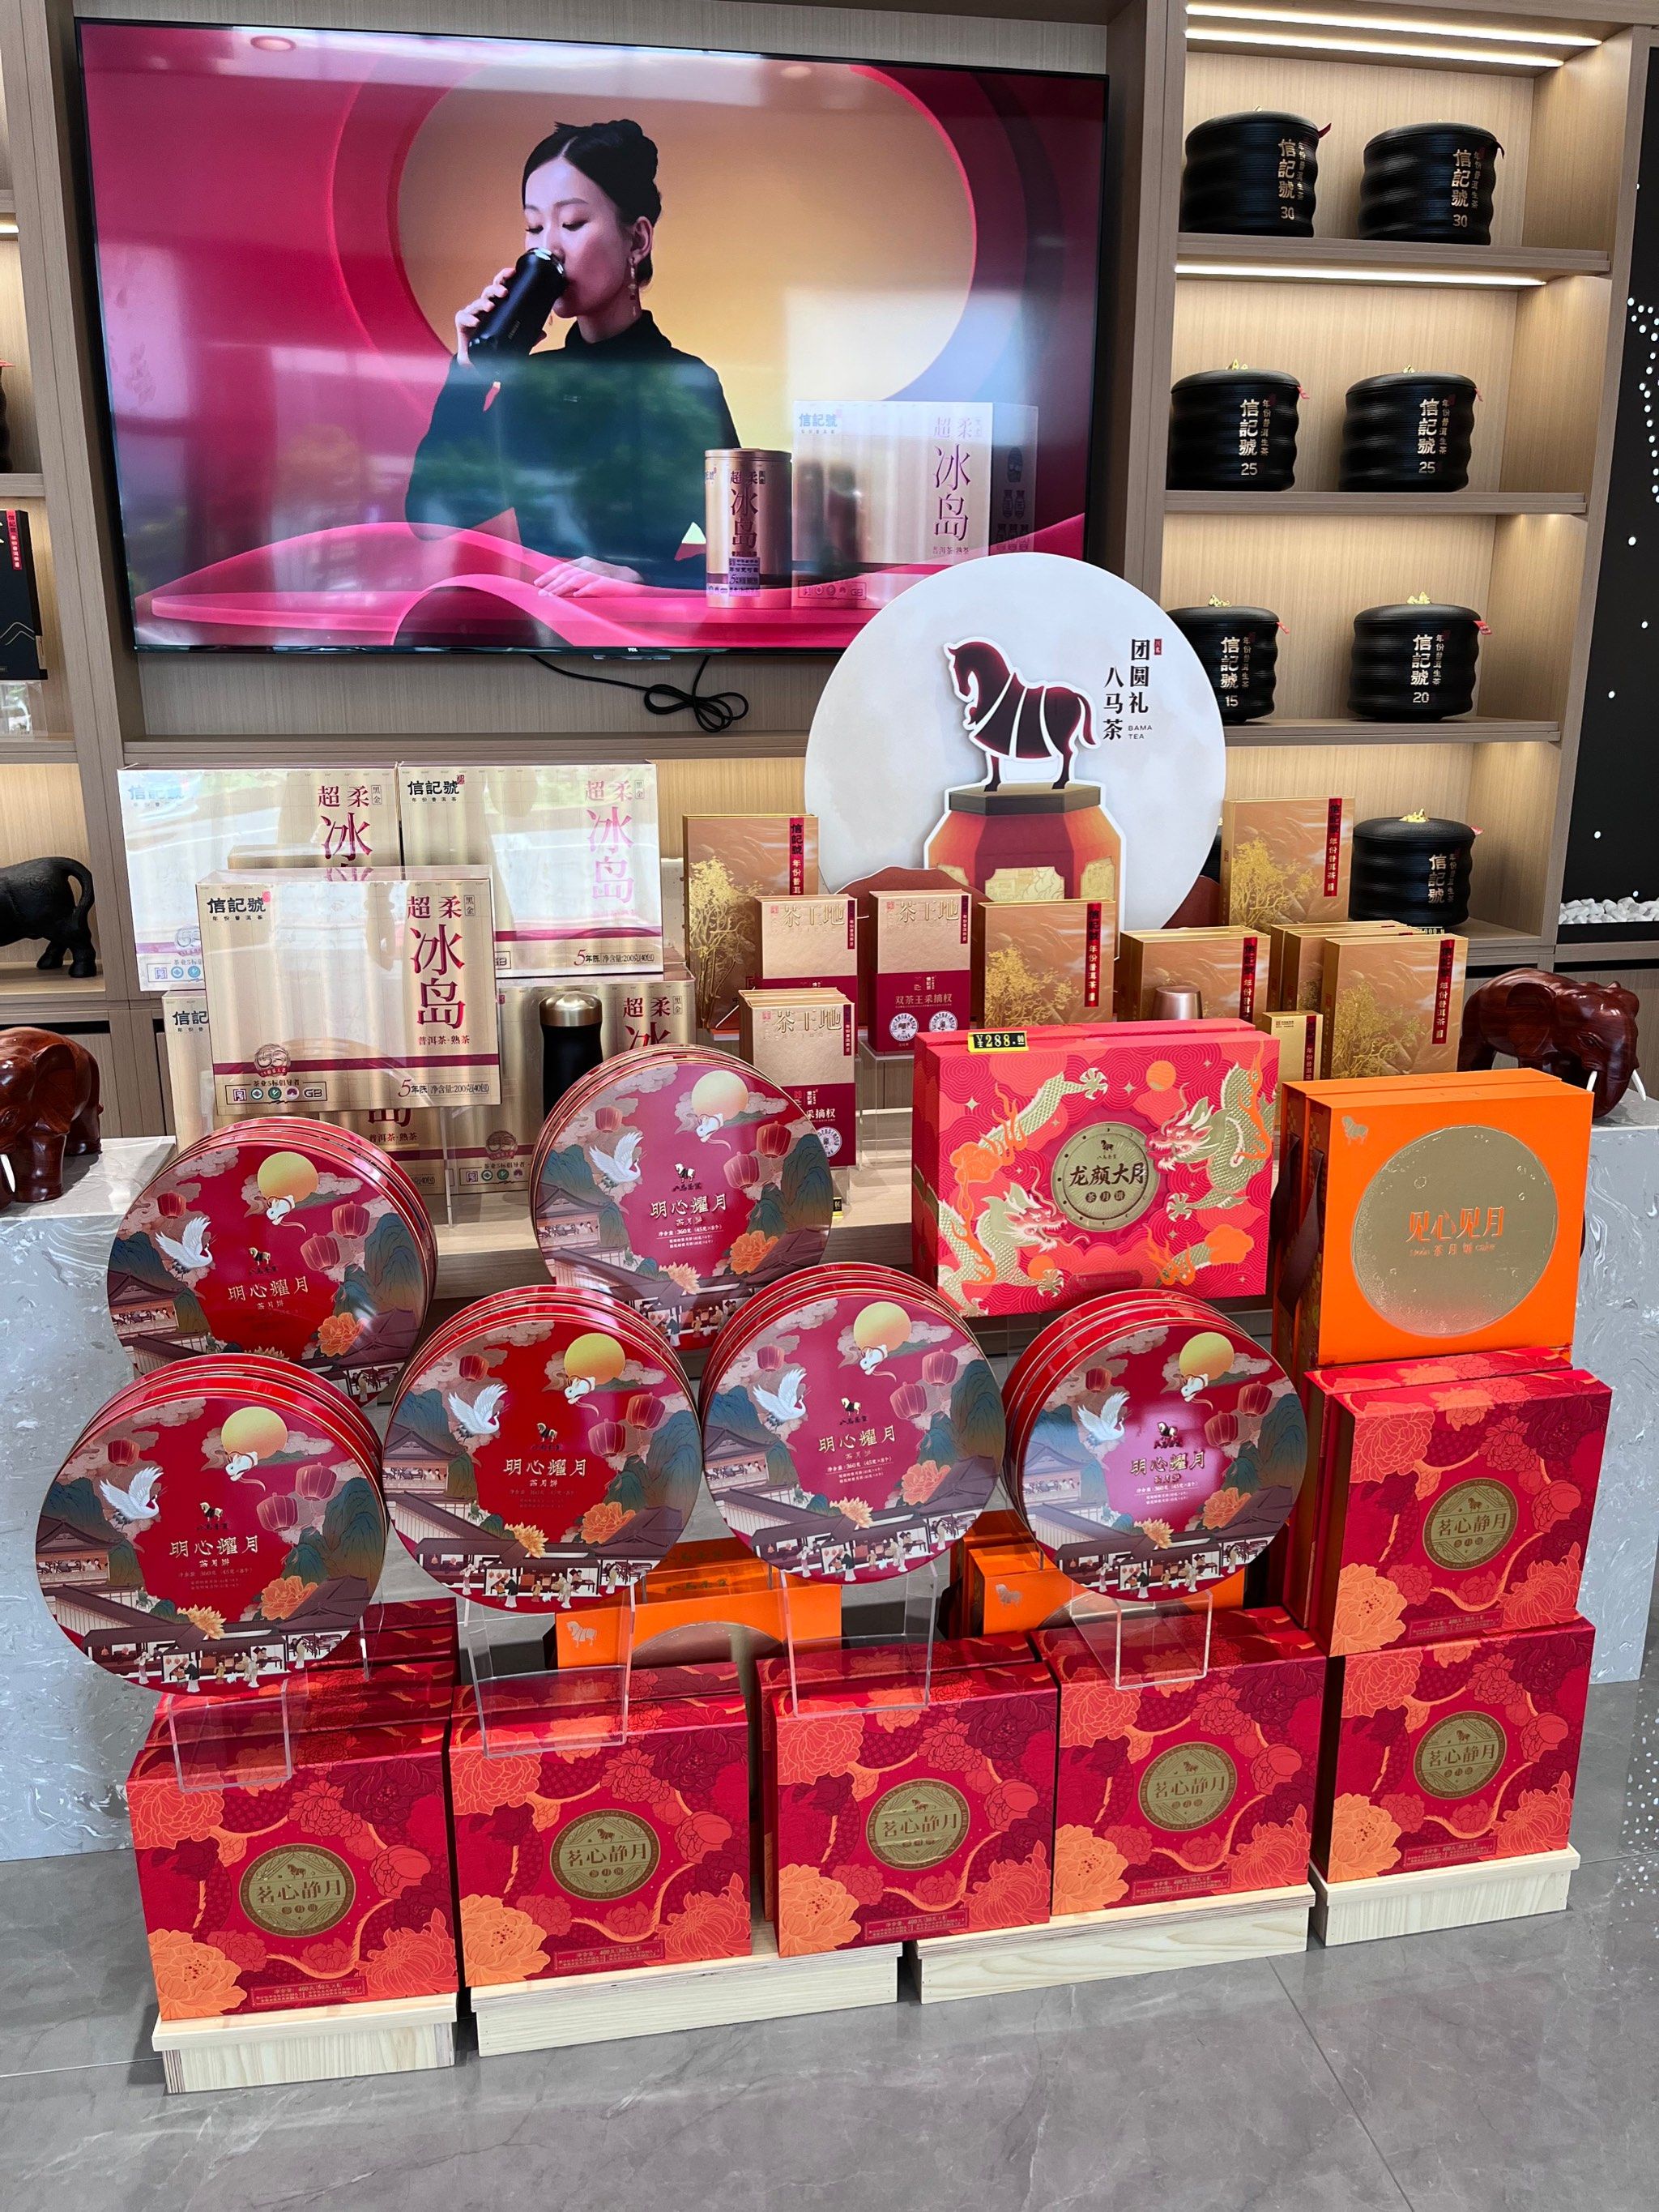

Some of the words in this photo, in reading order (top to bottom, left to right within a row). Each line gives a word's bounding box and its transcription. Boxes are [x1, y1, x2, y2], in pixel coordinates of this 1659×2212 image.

[1277, 139, 1295, 199] 信記號
[1451, 148, 1471, 207] 信記號
[1280, 206, 1294, 220] 30
[1452, 214, 1468, 228] 30
[799, 412, 838, 428] 信記號
[933, 416, 972, 438] 超柔
[1239, 399, 1260, 456] 信記號
[1418, 398, 1439, 455] 信記號
[731, 471, 757, 485] 超柔
[1240, 463, 1258, 476] 25
[1418, 461, 1435, 474] 25
[933, 443, 971, 541] 冰岛
[731, 487, 759, 549] 冰岛
[1220, 636, 1240, 689] 信記號
[1410, 634, 1433, 685] 信記號
[1128, 638, 1150, 714] 团圆礼
[1102, 666, 1124, 741] 八马茶
[1225, 695, 1239, 707] 15
[1413, 692, 1430, 703] 20
[318, 785, 370, 808] 超柔
[407, 780, 459, 796] 信記號
[585, 780, 633, 802] 超柔
[321, 812, 373, 867] 冰
[587, 806, 634, 904] 冰岛
[1428, 854, 1447, 903] 信記號
[207, 898, 266, 913] 信記號
[407, 895, 462, 919] 超柔
[410, 925, 465, 1029] 冰岛
[623, 997, 671, 1018] 超柔
[1243, 979, 1253, 1014] 年份普洱
[173, 1011, 209, 1025] 信記
[304, 1088, 323, 1098] GB
[1068, 1162, 1145, 1187] 龙颜大月
[650, 1194, 726, 1219] 明心耀月
[1405, 1206, 1504, 1243] 见心见月
[228, 1276, 308, 1302] 明心耀月
[818, 1424, 895, 1454] 明心耀月
[503, 1458, 586, 1476] 明心耀月
[1130, 1450, 1205, 1476] 明心耀月
[1439, 1513, 1507, 1536] 茗心静月
[169, 1535, 258, 1559] 明心耀月
[1427, 1744, 1495, 1767] 茗心静月
[1154, 1776, 1225, 1799] 茗心静月
[883, 1814, 957, 1837] 茗心静月
[568, 1843, 646, 1867] 茗心静月
[257, 1880, 341, 1903] 茗心静月
